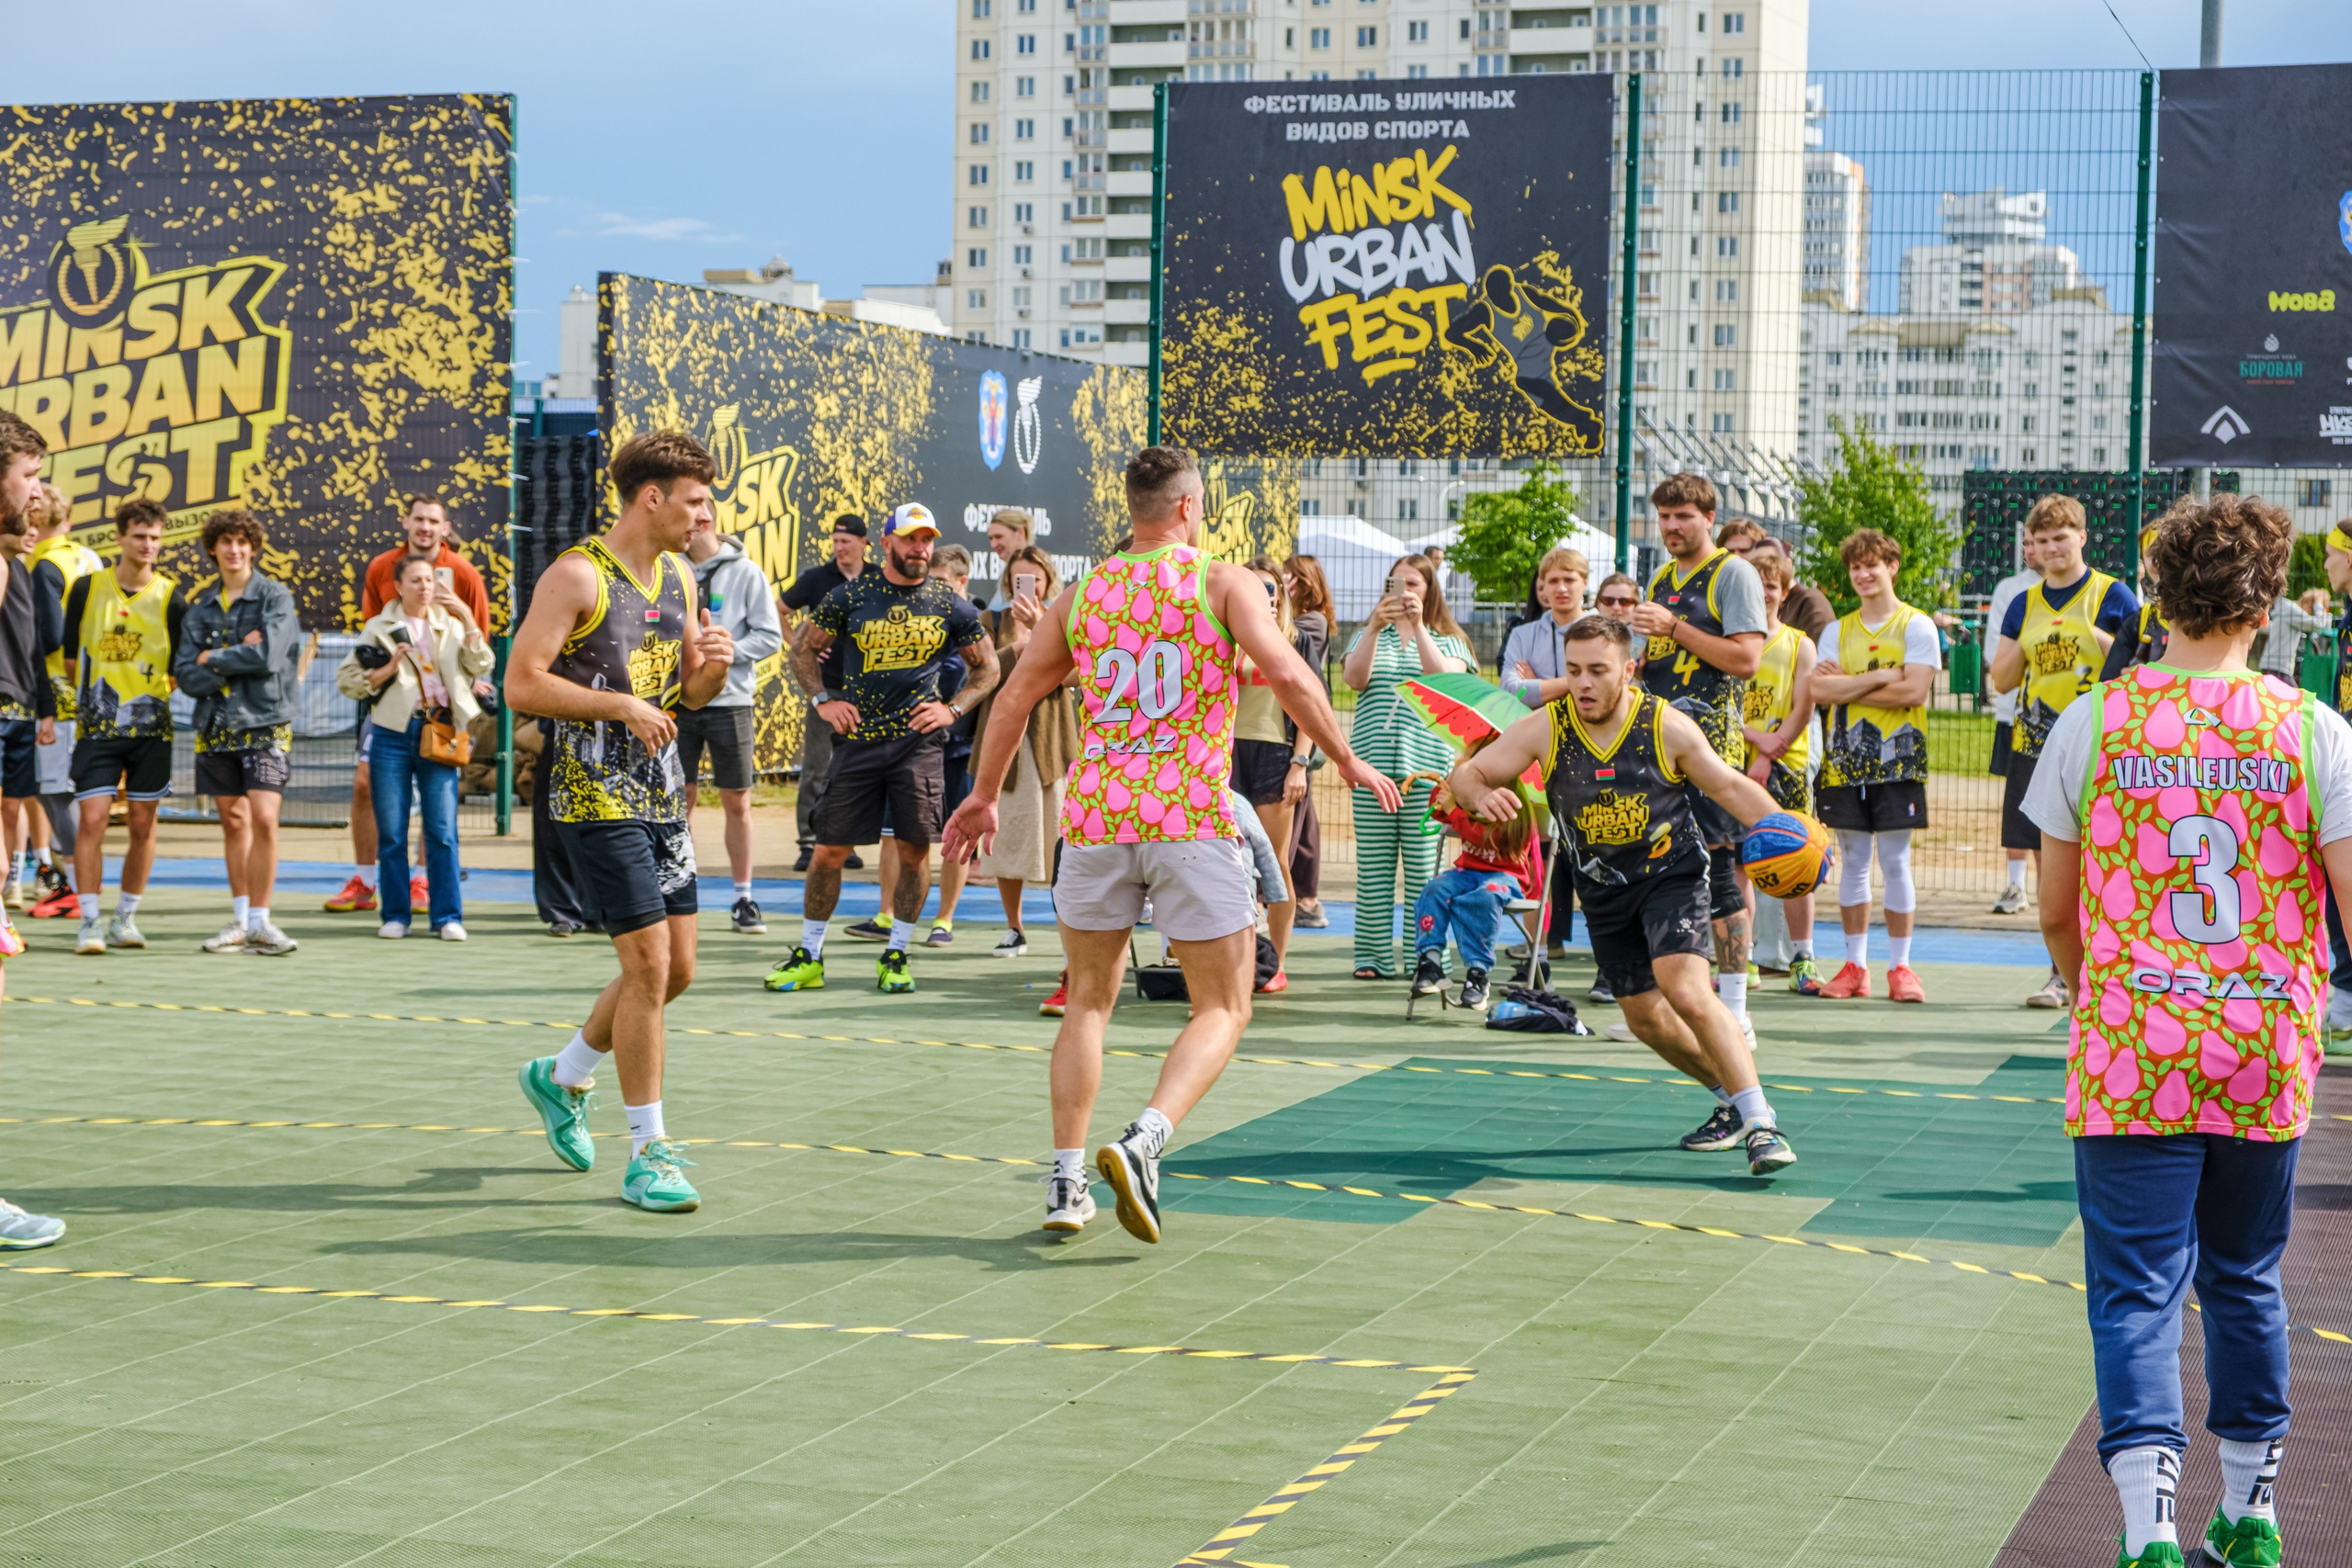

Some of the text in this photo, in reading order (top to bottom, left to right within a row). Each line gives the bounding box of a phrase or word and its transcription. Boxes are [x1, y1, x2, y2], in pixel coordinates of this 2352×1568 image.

[1244, 90, 1516, 115] ФЕСТИВАЛЬ УЛИЧНЫХ
[1286, 119, 1470, 143] ВИДОВ СПОРТА
[1279, 209, 1476, 303] URBAN
[1298, 282, 1467, 370] FEST
[2240, 361, 2303, 378] БОРОВАЯ
[0, 334, 268, 454] RBAN
[40, 416, 241, 526] EST
[1052, 555, 1092, 582] ПОРТА
[864, 617, 937, 634] MINSK
[860, 630, 941, 649] URBAN
[629, 642, 678, 664] MINSK
[867, 645, 933, 667] FEST
[1673, 649, 1700, 686] 4
[631, 671, 668, 695] FEST
[1091, 640, 1182, 724] 20
[1084, 735, 1176, 761] ORAZ
[2112, 756, 2290, 795] VASILEUSKI
[1580, 807, 1645, 829] URBAN
[1582, 795, 1641, 818] MINSK
[1589, 822, 1640, 842] FEST
[2168, 814, 2242, 945] 3
[2131, 968, 2291, 1001] ORAZ
